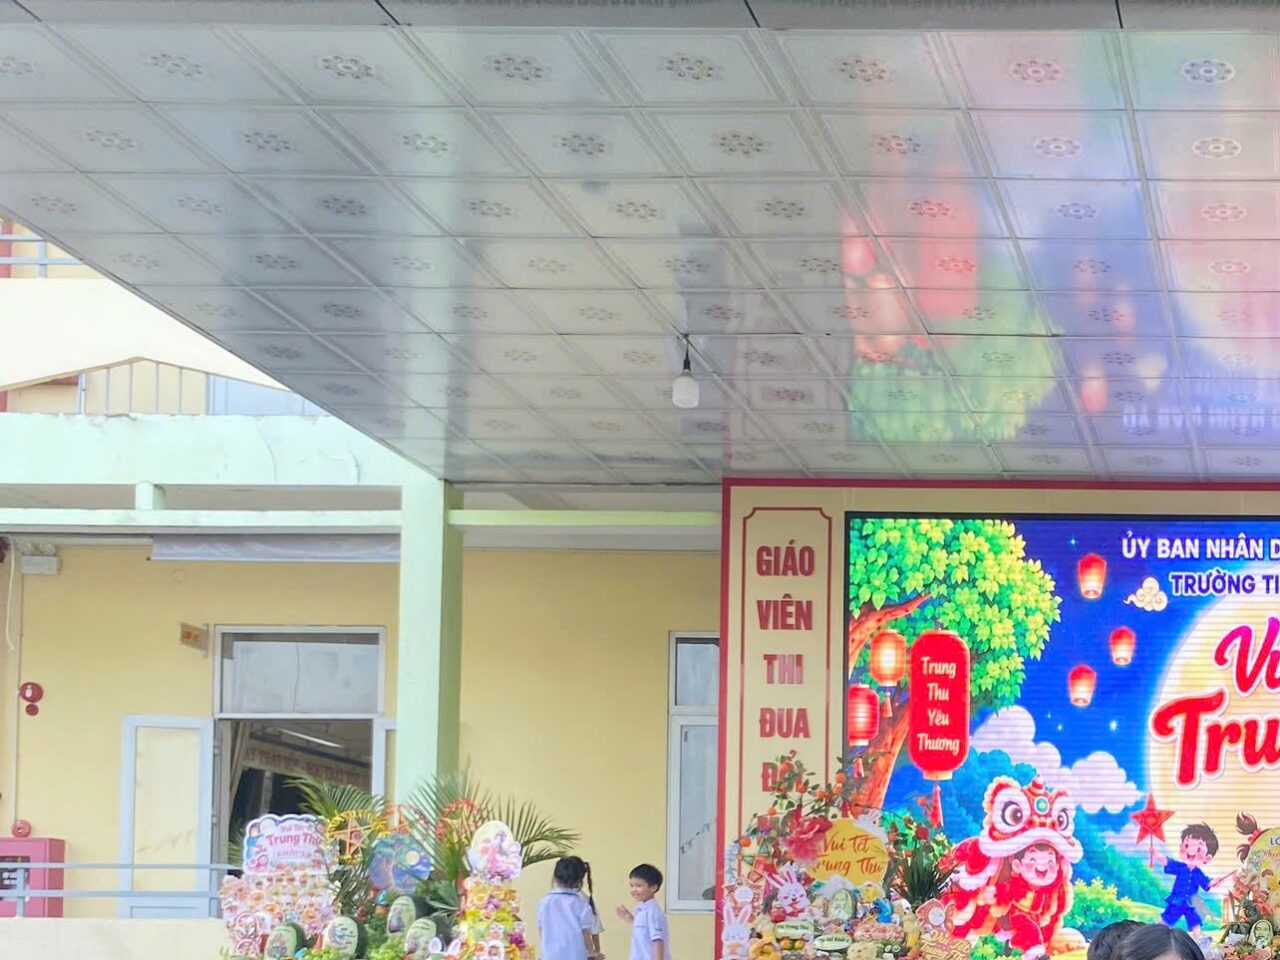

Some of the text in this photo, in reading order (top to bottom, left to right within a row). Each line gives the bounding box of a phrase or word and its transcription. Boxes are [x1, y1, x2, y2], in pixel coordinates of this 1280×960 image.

[1122, 531, 1149, 559] ỦY
[1157, 537, 1199, 559] BAN
[1206, 532, 1263, 559] NHÂN
[756, 539, 815, 577] GIÁO
[1170, 569, 1256, 595] TRƯỜNG
[757, 593, 813, 631] VIÊN
[763, 653, 804, 684] THI
[921, 656, 957, 679] Trung
[927, 682, 950, 701] Thu
[758, 707, 811, 738] ĐUA
[927, 707, 950, 727] Yêu
[917, 733, 960, 756] Thương
[265, 833, 300, 846] Trung
[824, 832, 846, 853] Vui
[857, 857, 884, 875] Thu
